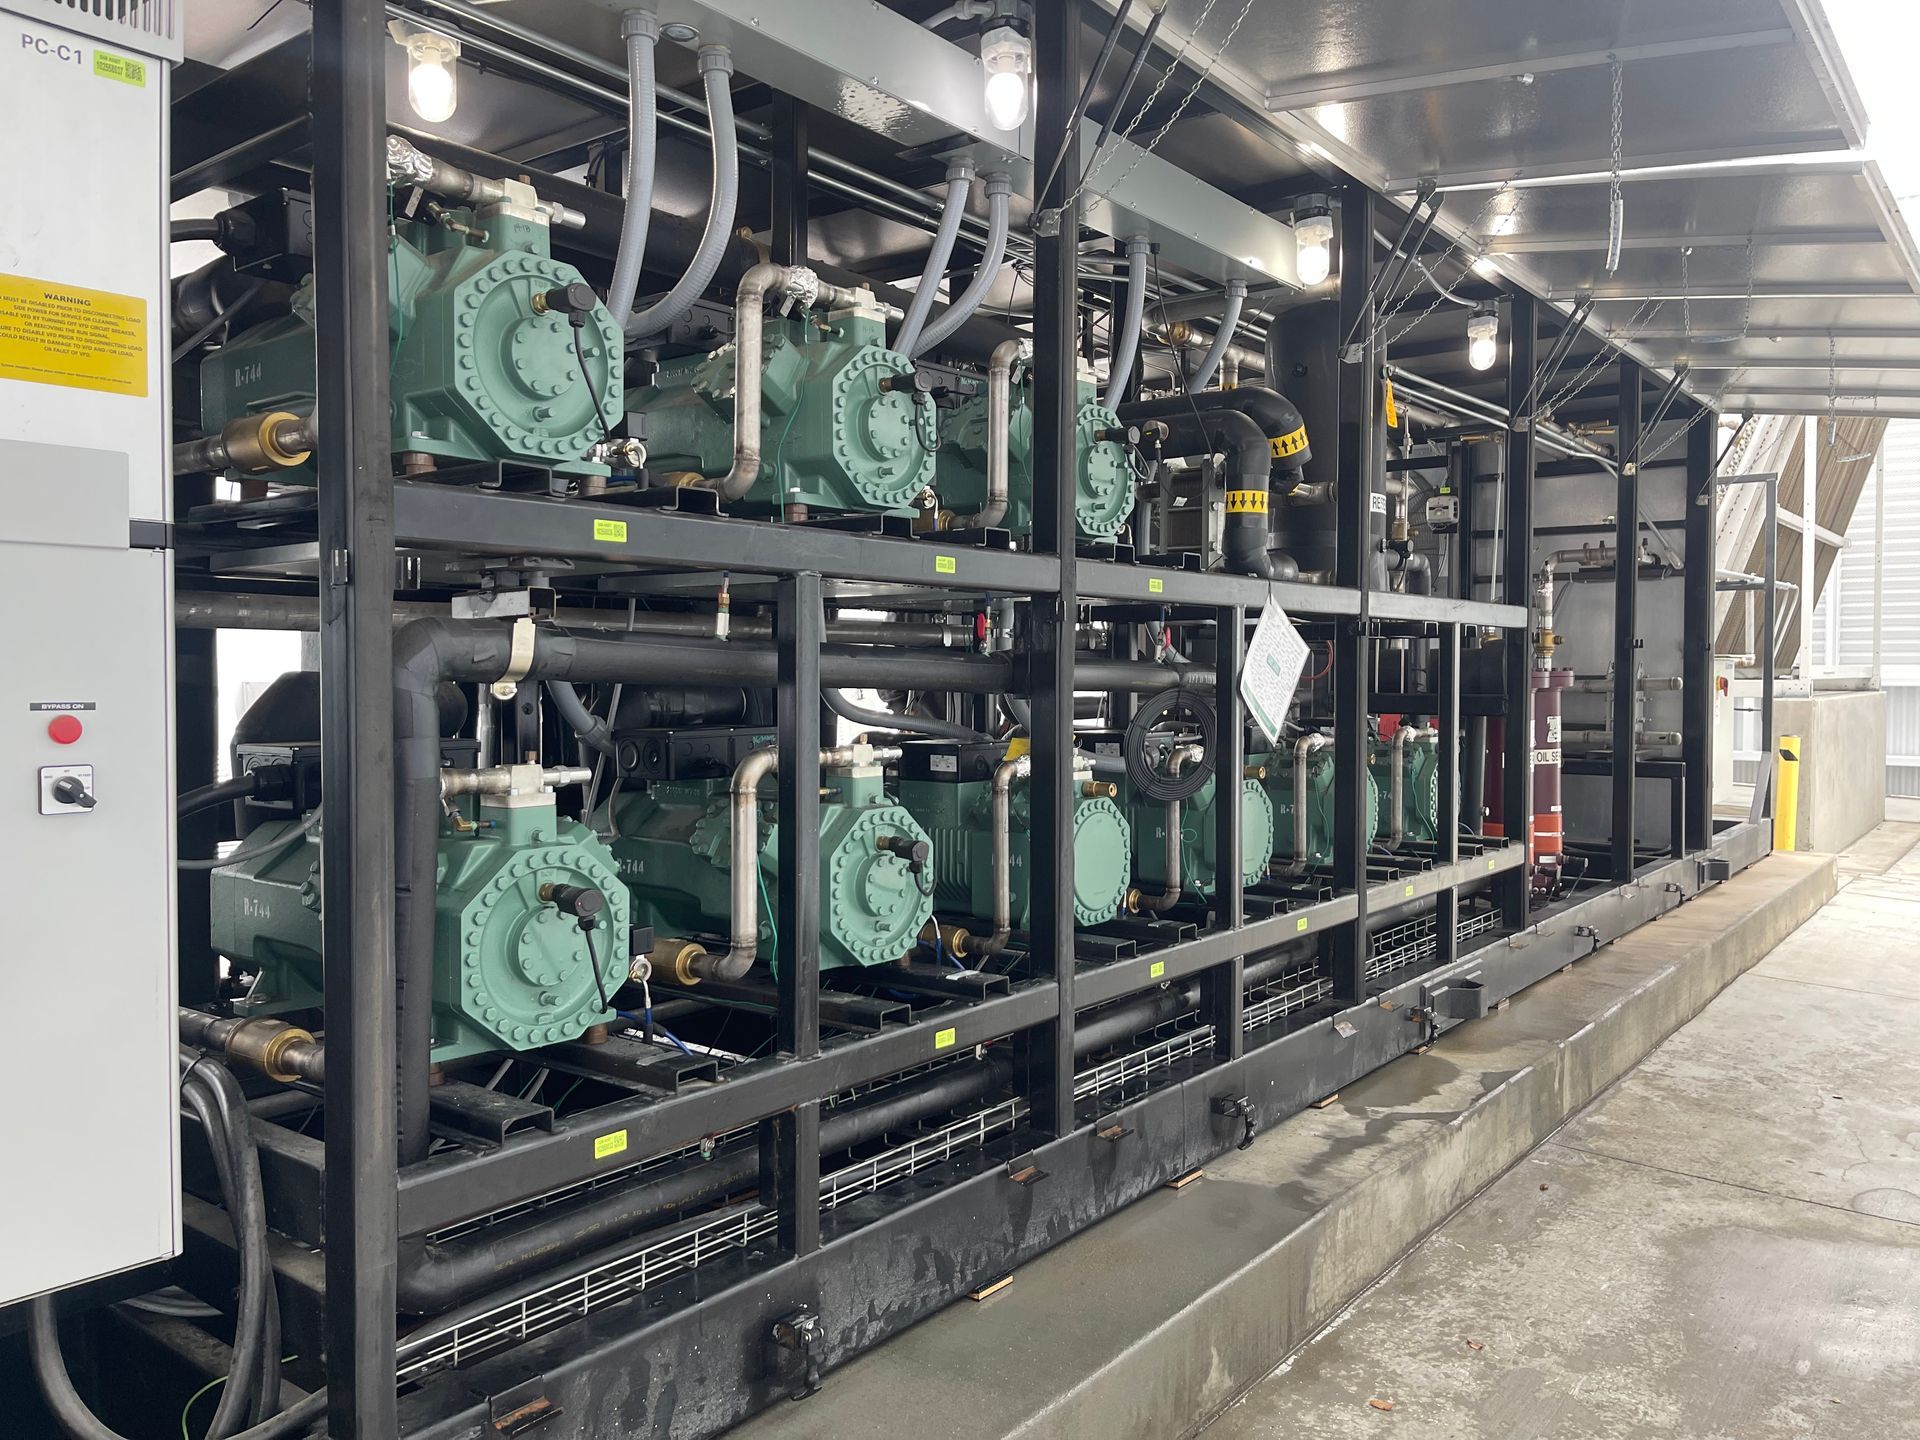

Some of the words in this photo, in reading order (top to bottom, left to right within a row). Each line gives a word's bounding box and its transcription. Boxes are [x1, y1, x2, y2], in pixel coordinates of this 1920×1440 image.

[22, 34, 82, 64] PC-C1
[44, 292, 91, 306] WARNING
[29, 300, 56, 308] DISABLED
[22, 328, 45, 336] DISABLE
[47, 339, 72, 347] DAMAGE
[1537, 752, 1550, 762] OIL
